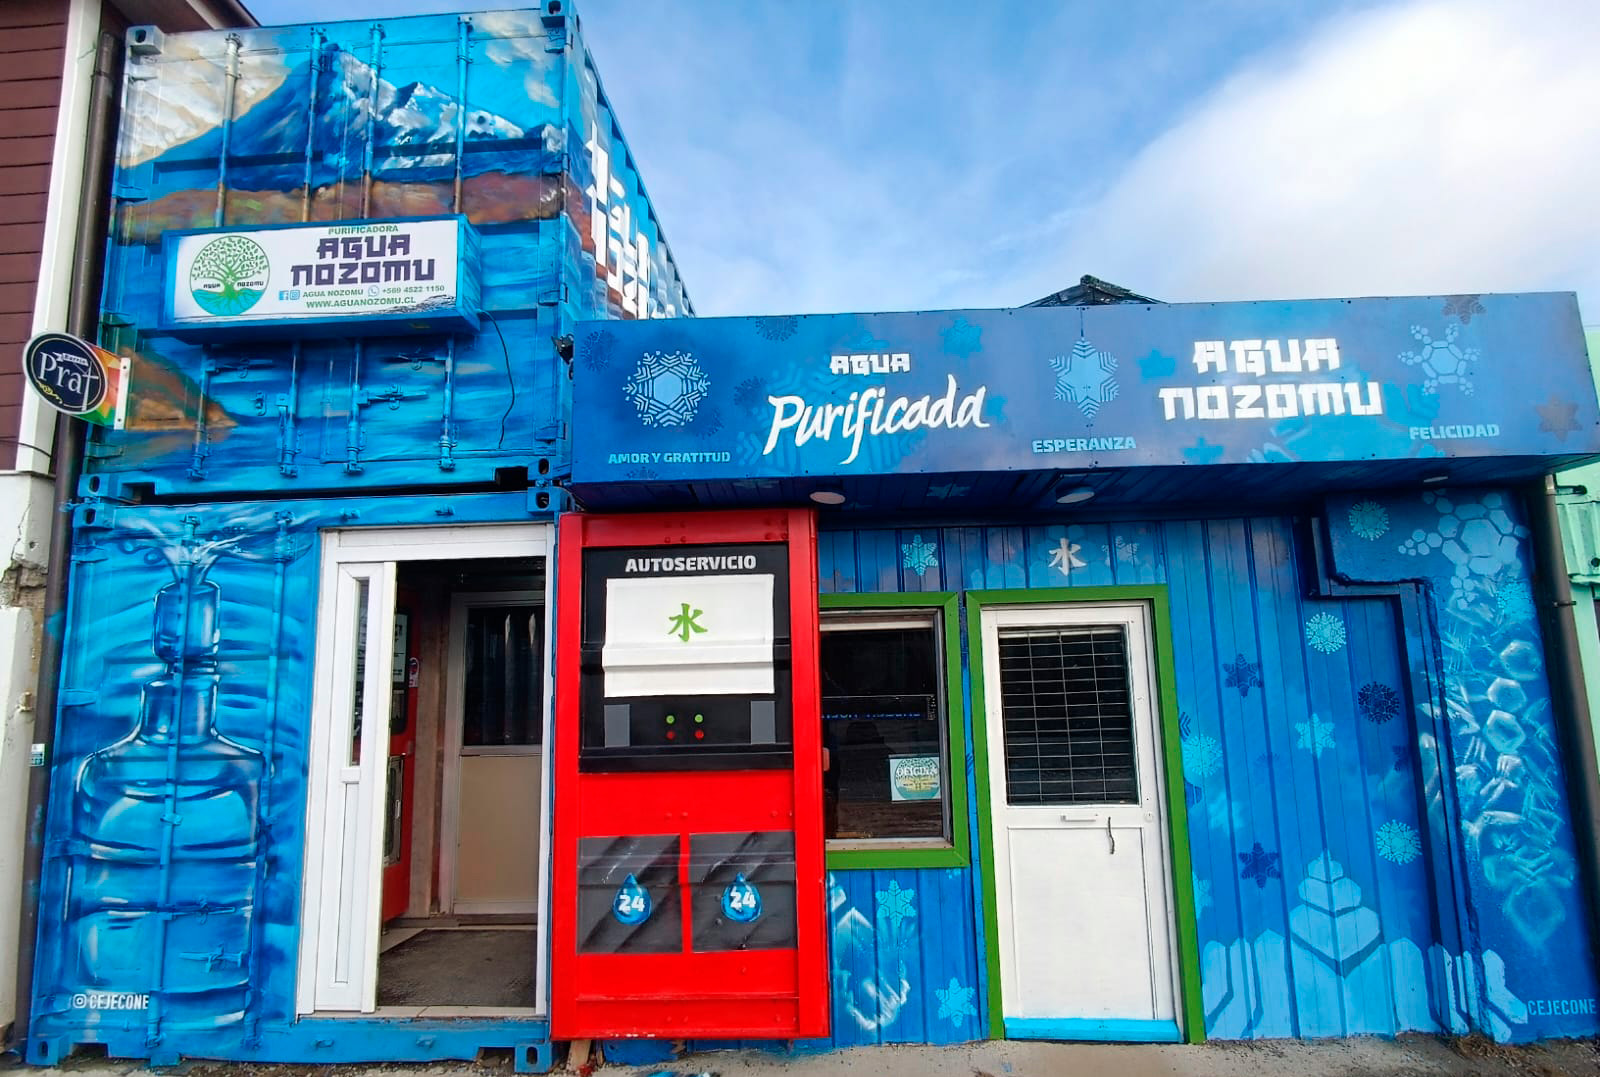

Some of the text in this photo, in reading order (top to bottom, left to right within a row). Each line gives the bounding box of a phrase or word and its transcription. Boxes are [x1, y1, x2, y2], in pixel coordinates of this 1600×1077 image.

[328, 225, 399, 235] PURIFICADORA
[317, 234, 411, 261] AGUA
[291, 259, 435, 287] NOZOMU
[302, 289, 364, 298] AGUA NOZOMU
[305, 296, 416, 309] WWW.AGUANOZOMU.CL
[829, 353, 911, 376] AGUA
[1192, 338, 1341, 377] AGUA
[38, 352, 99, 411] Prat
[1158, 381, 1384, 421] NOZOMU
[762, 374, 990, 465] Purificada
[1408, 424, 1500, 440] FELICIDAD
[1032, 436, 1137, 453] ESPERANZA
[608, 451, 731, 464] AMOR Y GRATITUD
[625, 555, 757, 572] AUTOSERVICIO
[1047, 537, 1087, 577] 水
[667, 603, 708, 642] 水
[617, 893, 646, 914] 24
[729, 890, 757, 912] 24
[89, 994, 150, 1010] CEJECONE
[1527, 999, 1597, 1016] CEJECONE
